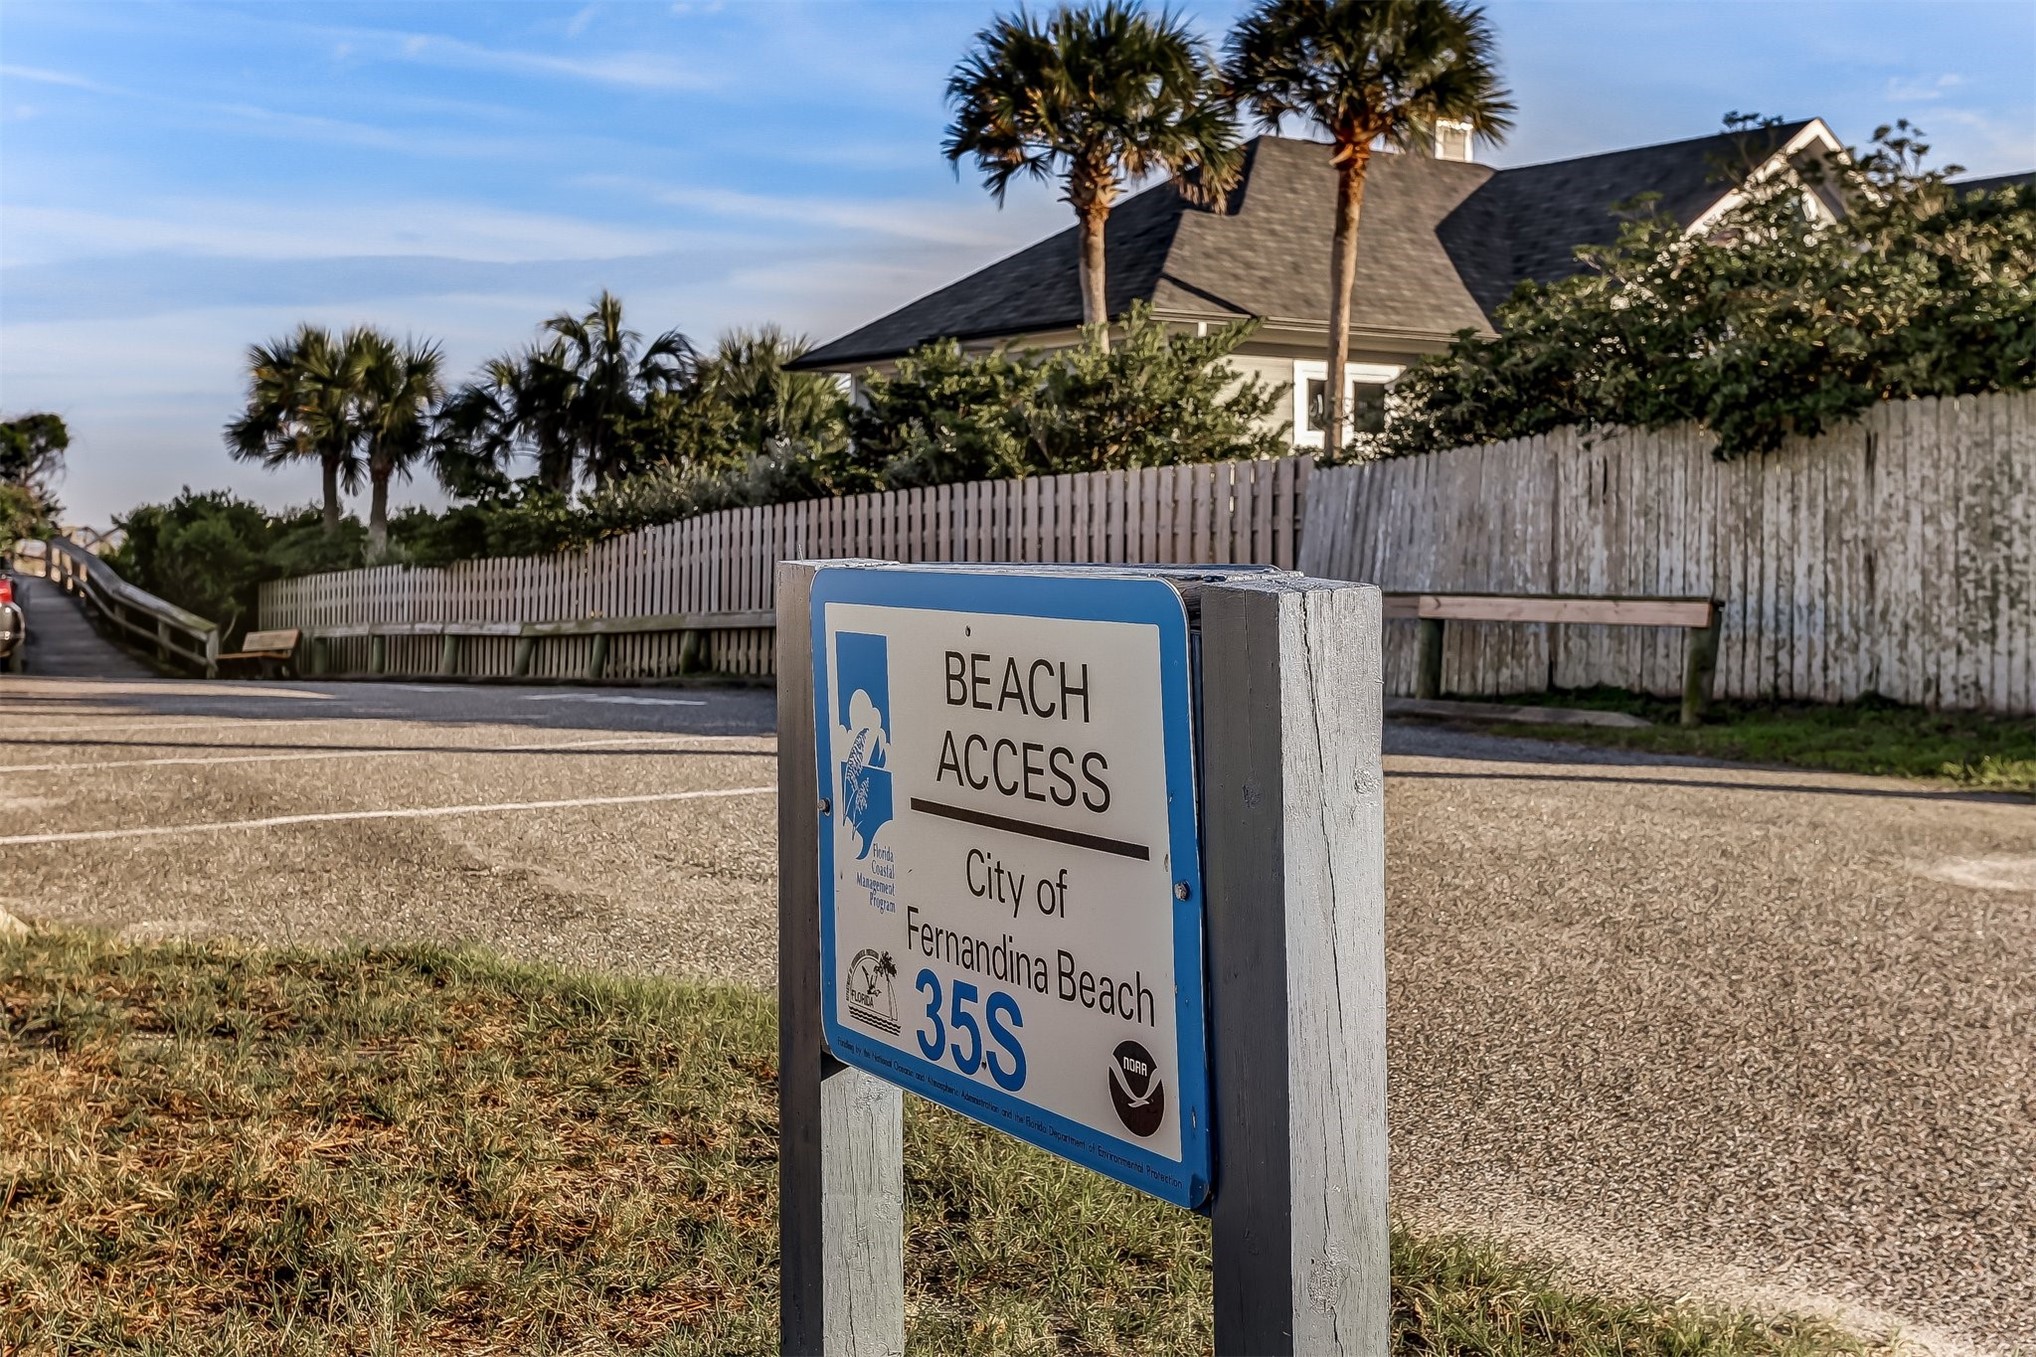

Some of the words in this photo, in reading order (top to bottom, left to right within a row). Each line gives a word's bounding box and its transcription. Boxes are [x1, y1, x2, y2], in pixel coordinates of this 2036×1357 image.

[945, 651, 1090, 723] BEACH
[936, 730, 1111, 814] ACCESS
[871, 860, 895, 879] Coastal
[873, 843, 894, 863] Florida
[857, 872, 895, 896] Management
[869, 891, 896, 914] Program
[966, 848, 1025, 918] City
[1037, 869, 1068, 918] of
[907, 905, 1049, 994] Fernandina
[1057, 949, 1155, 1027] Beach
[851, 988, 874, 1009] FLORIDA
[915, 968, 1027, 1092] 35S
[1123, 1056, 1148, 1077] NOAA
[1001, 1107, 1013, 1120] and
[1014, 1112, 1024, 1124] the
[1025, 1115, 1047, 1134] Florida
[1048, 1125, 1086, 1149] Department
[1088, 1143, 1096, 1154] of
[1146, 1165, 1183, 1189] Protection
